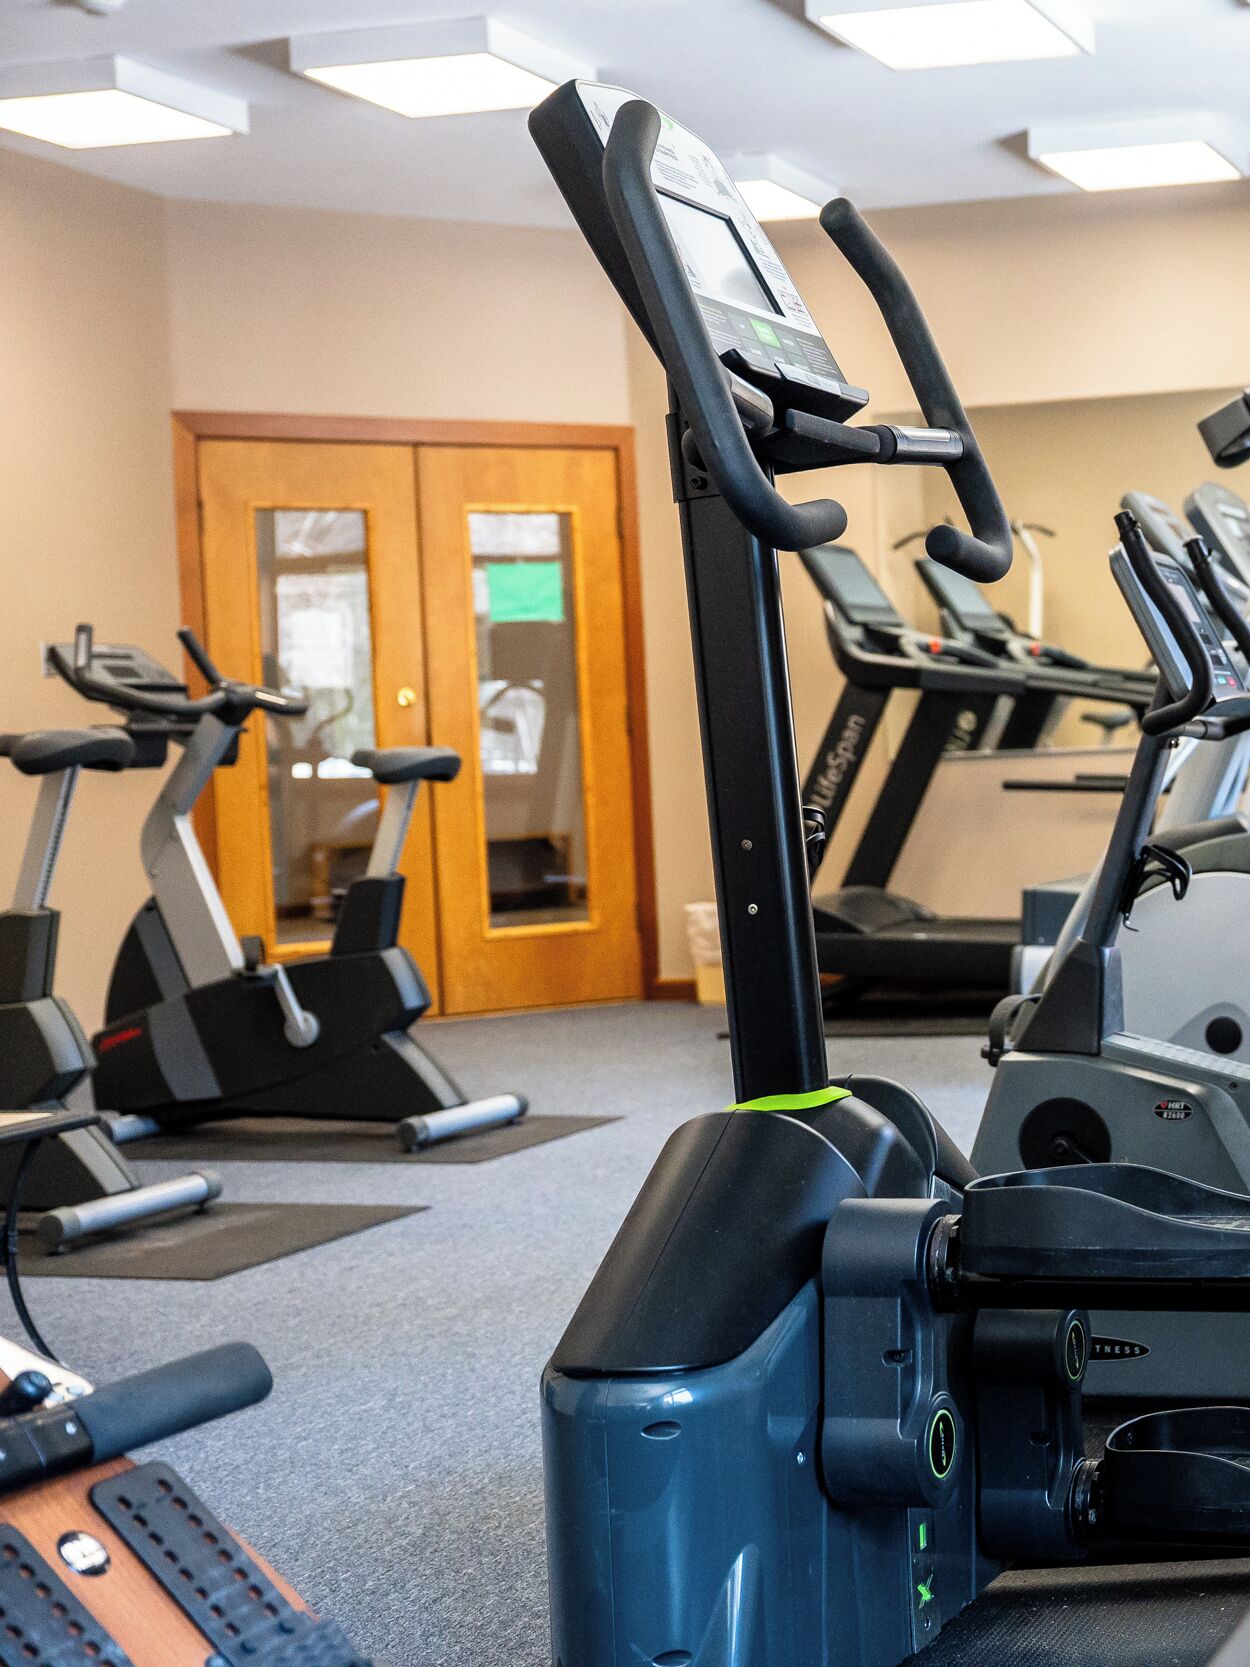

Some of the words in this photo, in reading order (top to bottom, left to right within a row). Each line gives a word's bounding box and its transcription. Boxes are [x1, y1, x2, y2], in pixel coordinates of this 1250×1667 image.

[809, 713, 868, 808] LifeSpan
[1167, 1101, 1185, 1109] HRT
[1094, 1344, 1141, 1354] TNESS
